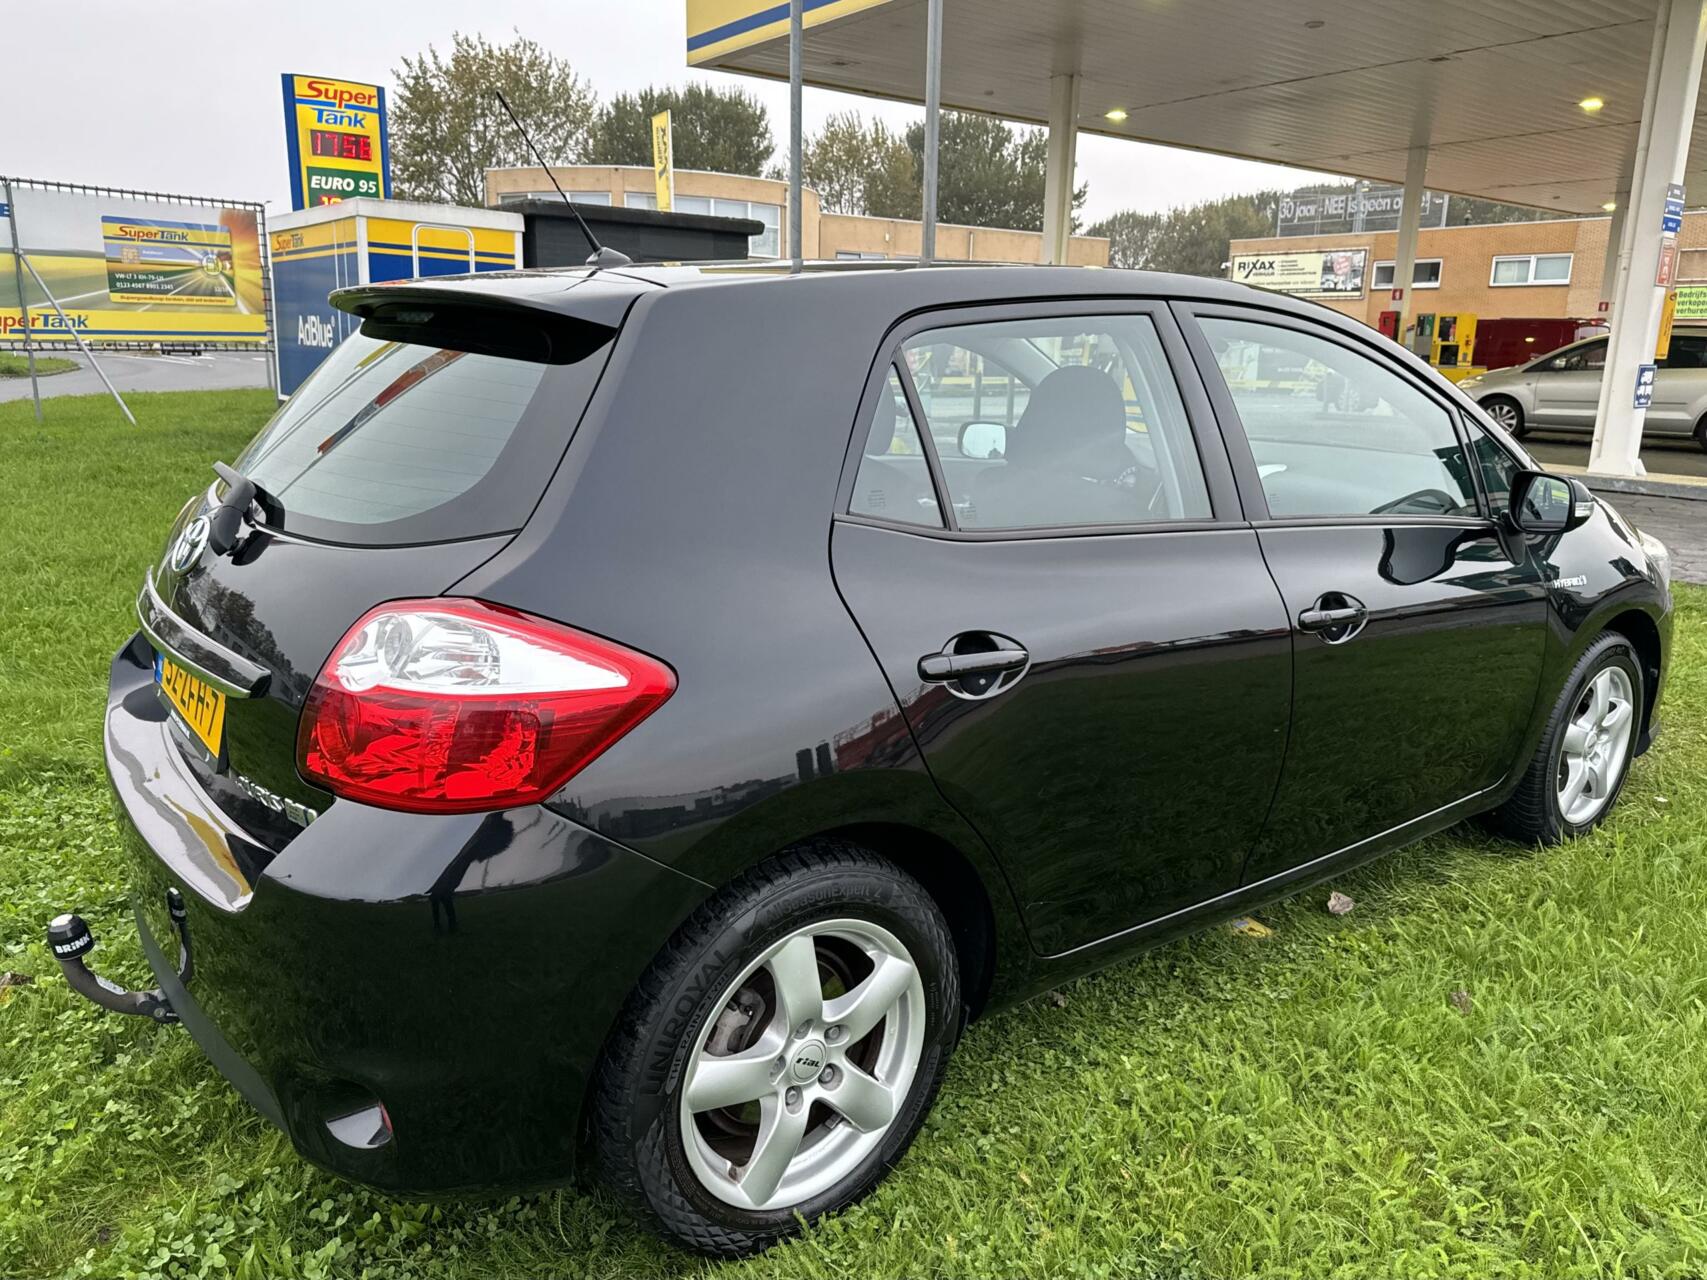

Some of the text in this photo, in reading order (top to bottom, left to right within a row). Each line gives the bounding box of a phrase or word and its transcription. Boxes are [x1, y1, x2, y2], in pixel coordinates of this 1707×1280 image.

[296, 80, 377, 109] Super
[310, 107, 367, 129] Tank
[311, 175, 377, 193] EURO 95
[1280, 201, 1293, 219] 30
[1293, 202, 1317, 223] jaar
[1324, 197, 1345, 216] NEE
[113, 225, 189, 242] SuperTank
[1238, 259, 1275, 279] RIXAX
[1677, 299, 1707, 307] verkope
[640, 950, 734, 1096] UNIROYAL
